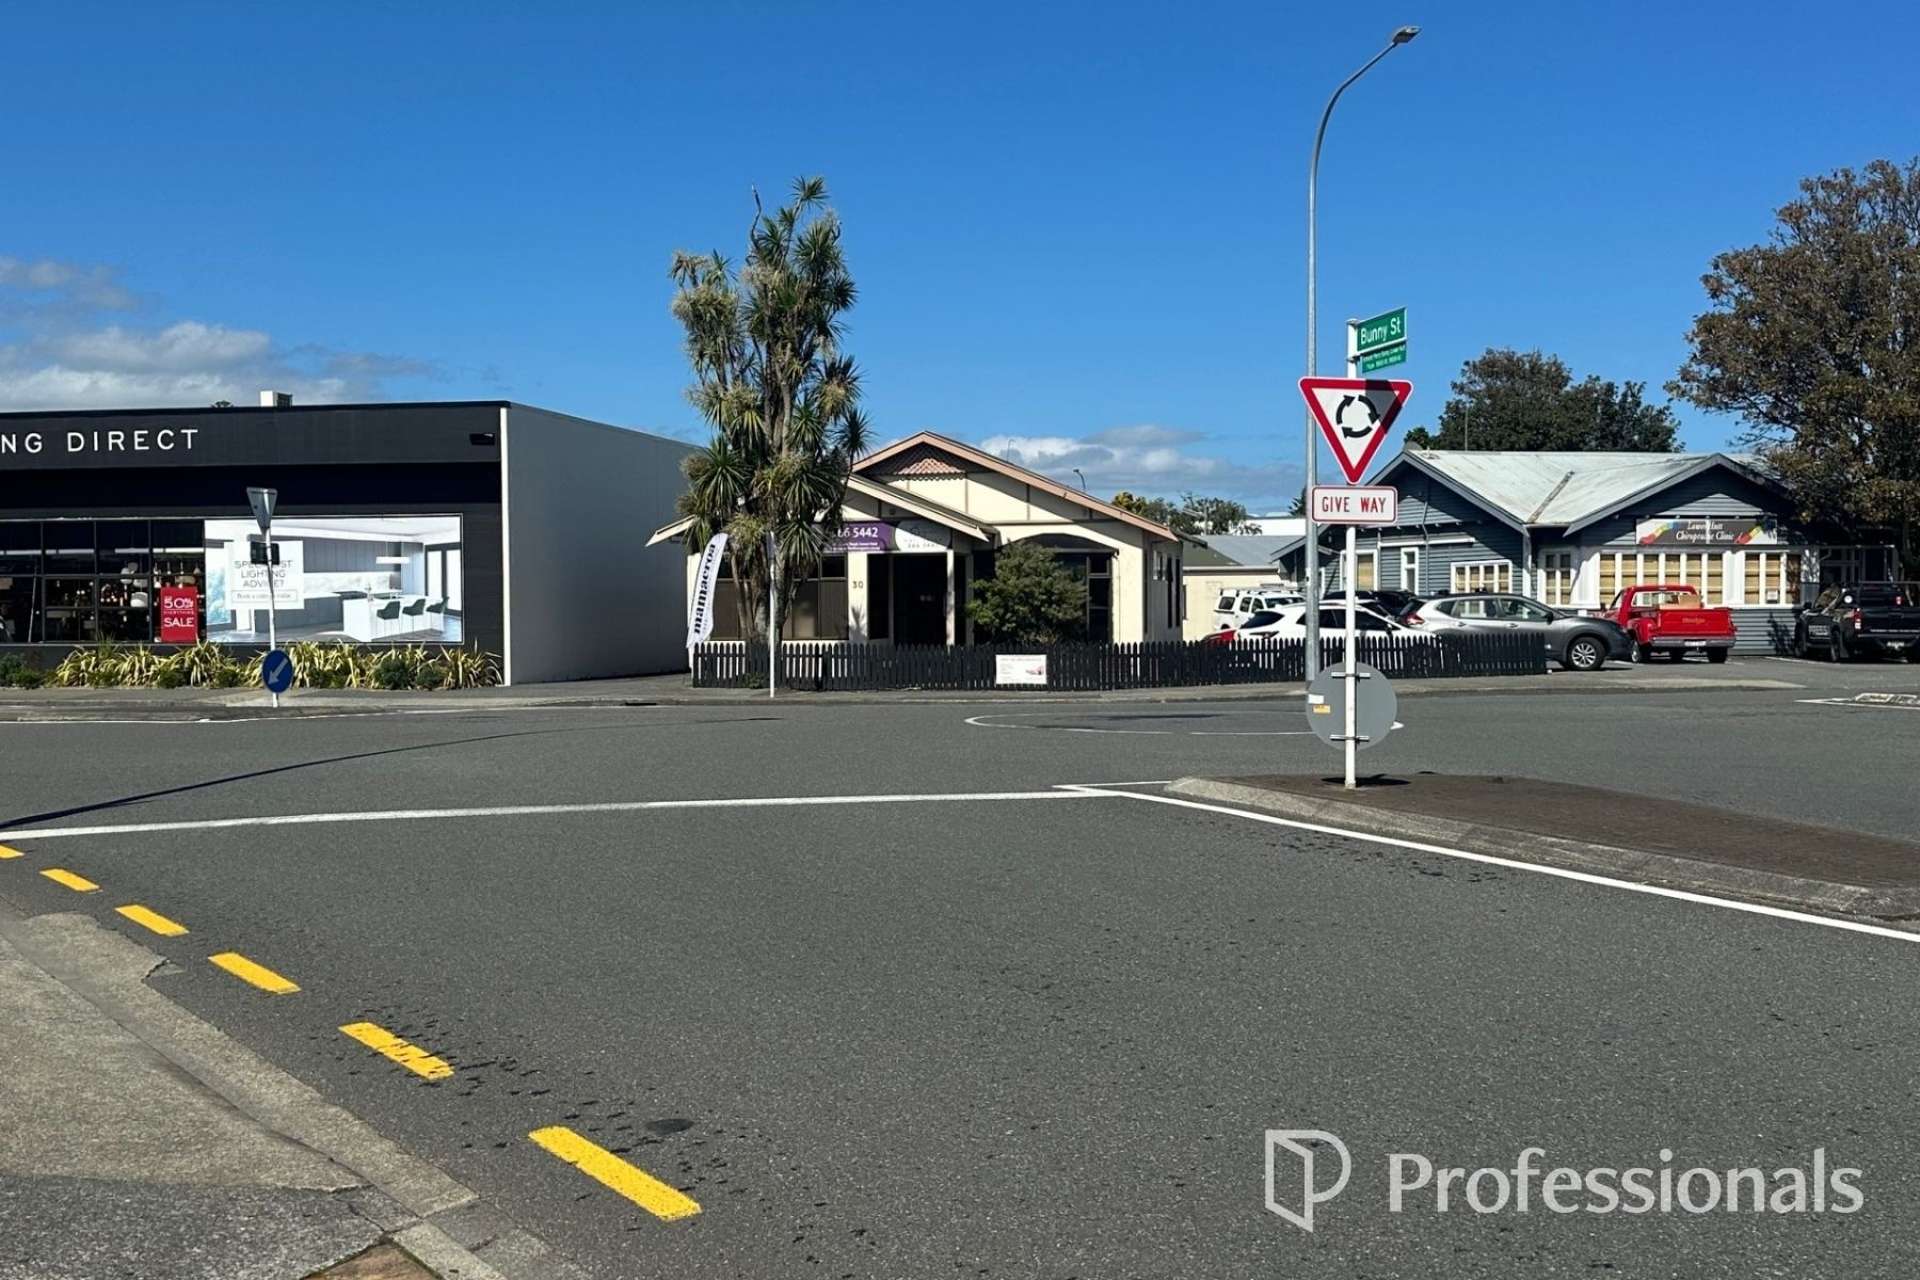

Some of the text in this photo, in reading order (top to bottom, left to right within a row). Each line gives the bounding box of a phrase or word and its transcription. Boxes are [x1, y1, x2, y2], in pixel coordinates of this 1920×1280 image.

[1360, 316, 1401, 345] Bunny St
[0, 429, 199, 453] NG DIRECT
[1322, 496, 1386, 513] GIVE WAY
[853, 526, 879, 538] 5442
[1676, 530, 1715, 543] Chiropraic
[241, 569, 286, 578] LIGHTNG
[164, 617, 195, 628] SALE
